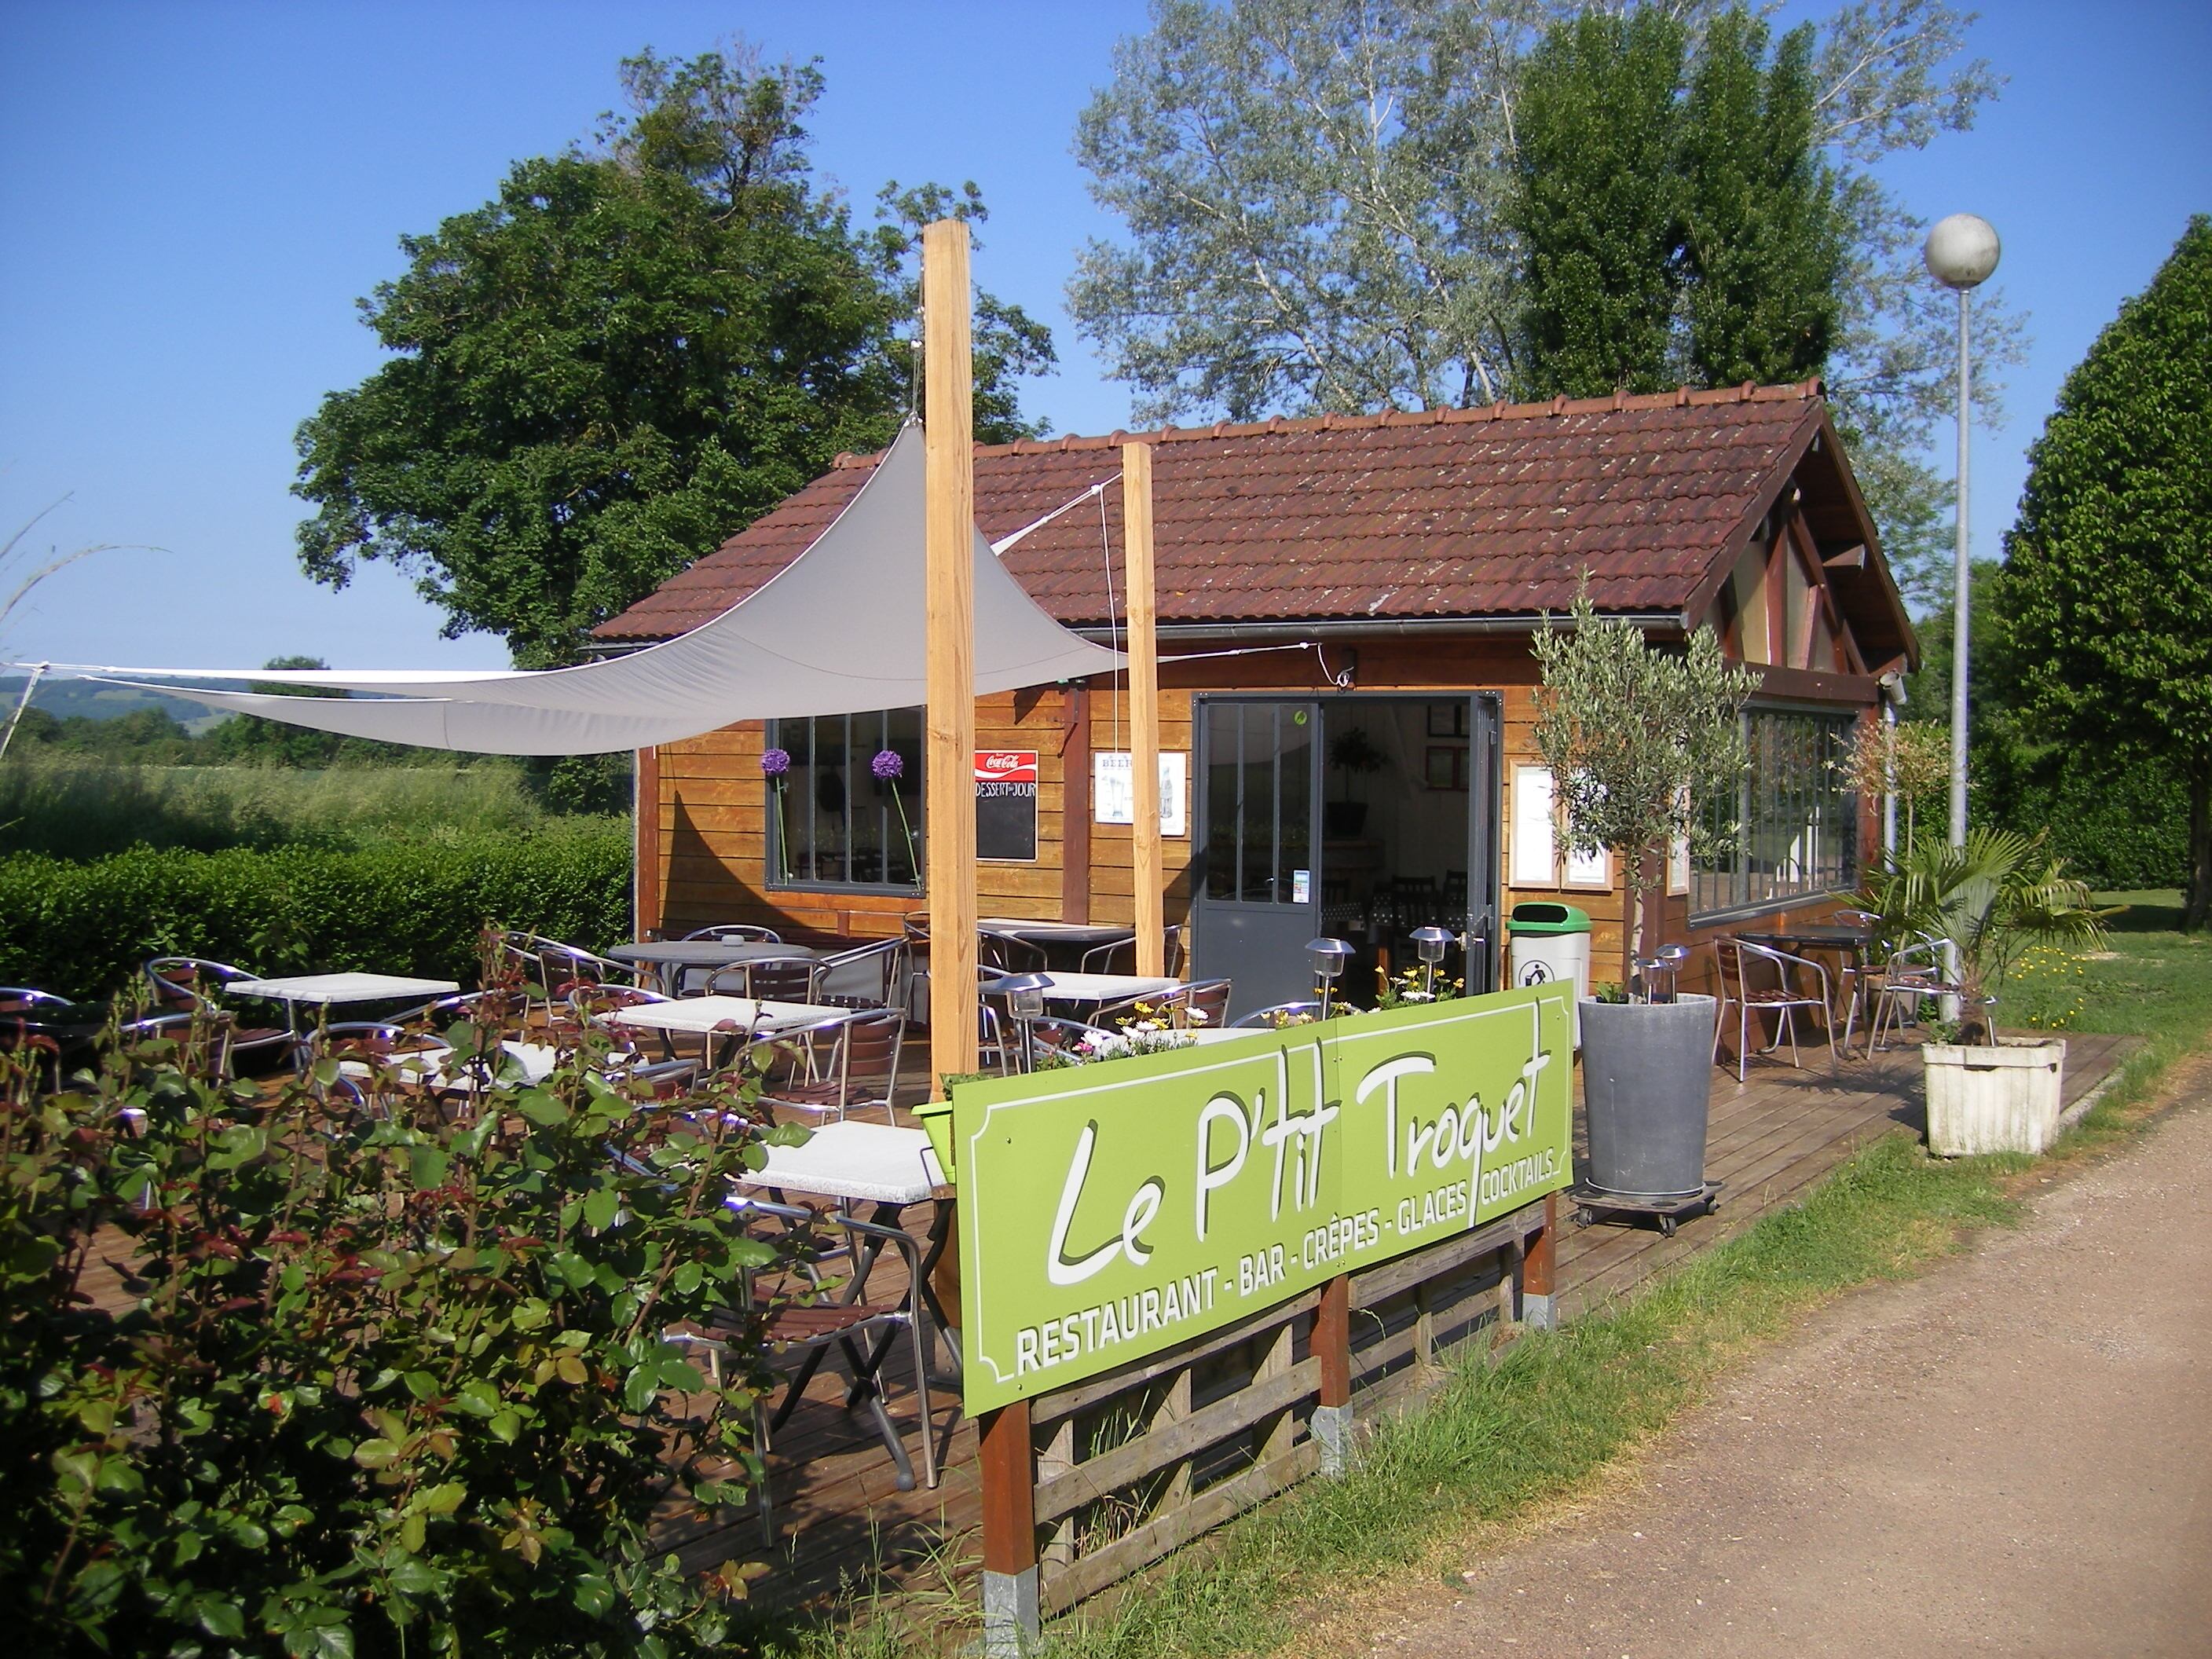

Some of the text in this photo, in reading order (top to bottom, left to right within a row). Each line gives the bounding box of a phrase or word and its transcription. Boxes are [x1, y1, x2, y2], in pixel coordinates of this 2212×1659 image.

[975, 782, 1010, 797] DESSERT
[1013, 782, 1036, 797] JOUR
[1047, 996, 1551, 1286] Le P'tit Troquet
[1016, 1265, 1218, 1377] RESTAURANT
[1240, 1242, 1286, 1297] BAR
[1303, 1207, 1380, 1270] CRÊPES
[1397, 1179, 1467, 1236] GLACES
[1481, 1146, 1555, 1206] COCKTAILS
